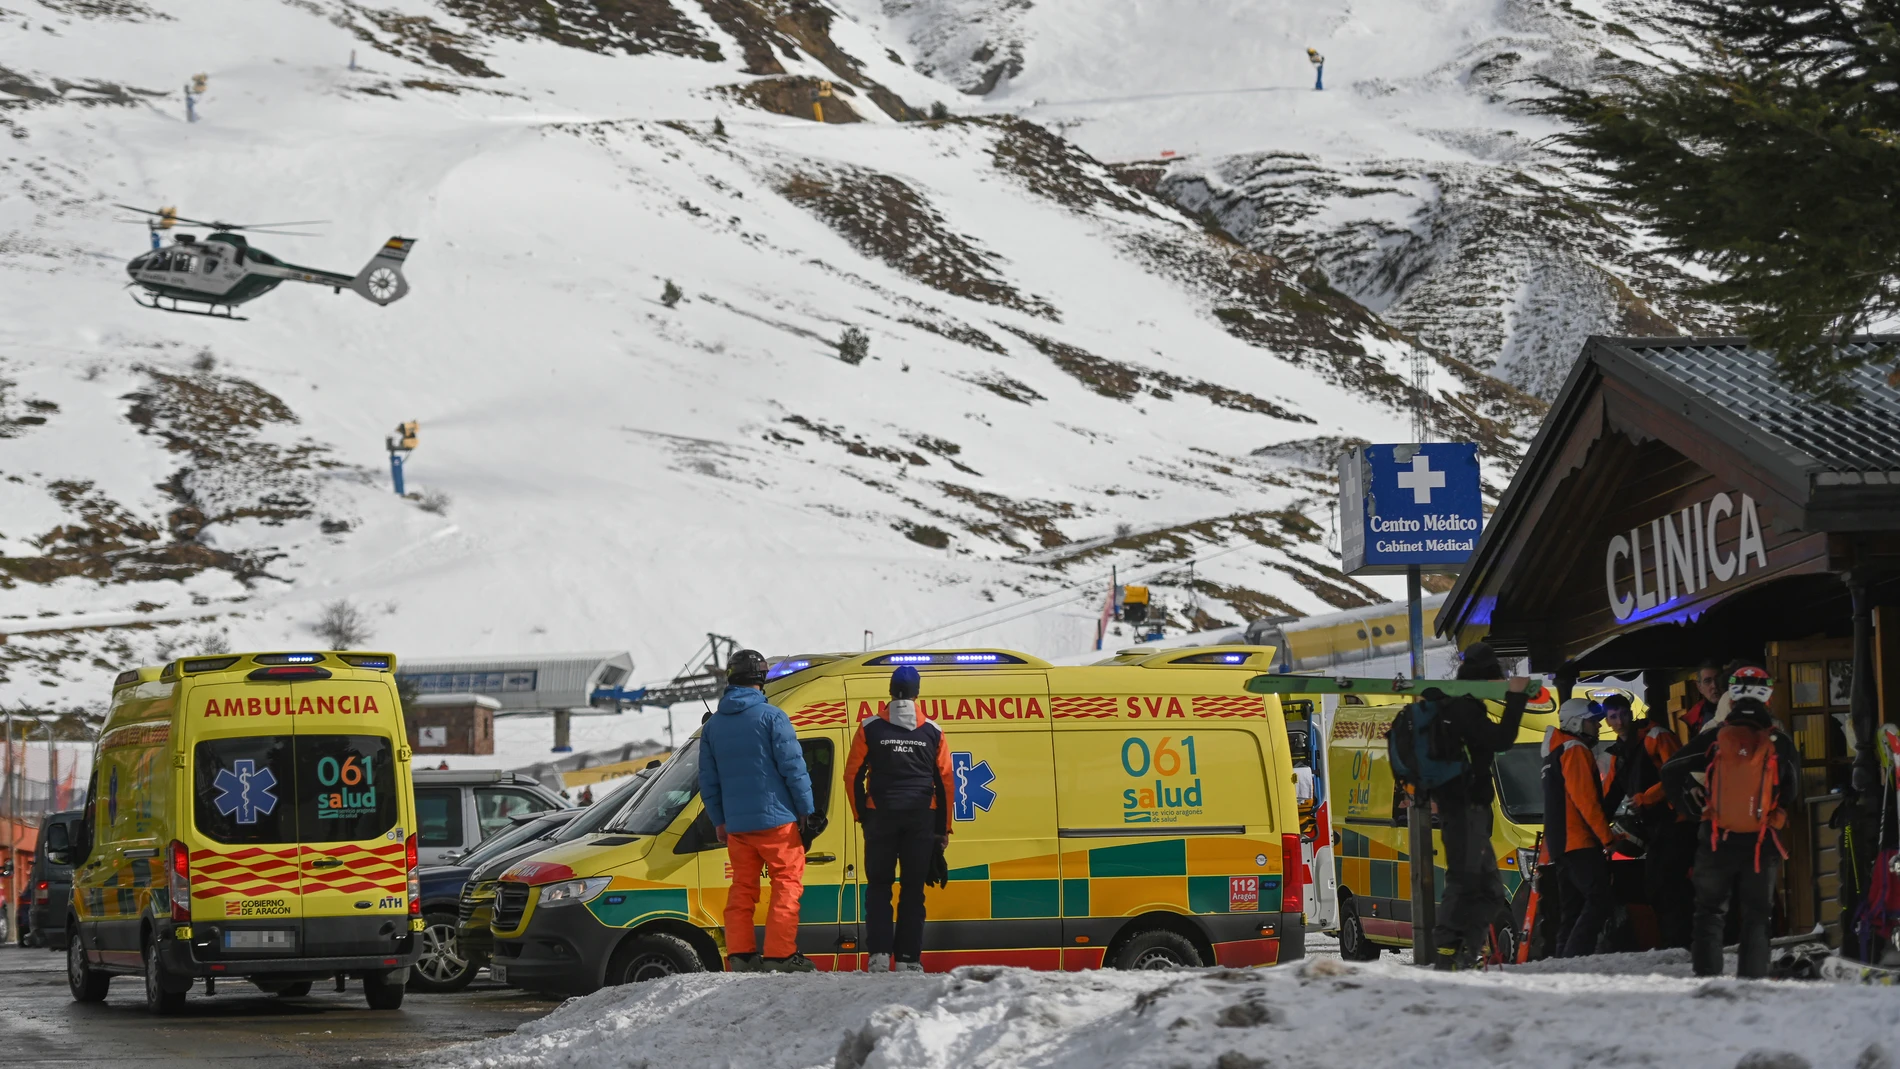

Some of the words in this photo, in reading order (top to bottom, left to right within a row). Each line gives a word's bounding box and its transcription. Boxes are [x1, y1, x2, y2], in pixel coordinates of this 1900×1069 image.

[1370, 515, 1420, 532] Centro
[1423, 513, 1477, 531] Médico
[1376, 540, 1423, 552] Cabinet
[1425, 538, 1473, 551] Médical
[1606, 492, 1767, 620] CLINICA
[204, 695, 379, 717] AMBULANCIA
[855, 697, 1045, 723] AULANCIA
[1126, 696, 1186, 719] SVA
[1359, 722, 1376, 739] SVB
[1121, 735, 1197, 778] 061
[1352, 750, 1374, 781] 061
[317, 755, 373, 787] 061
[317, 786, 376, 809] salud
[1122, 778, 1203, 810] salud
[1349, 783, 1370, 804] salud
[1231, 879, 1257, 892] 112
[241, 899, 285, 908] GOBIERNO
[378, 898, 403, 909] ATH
[1232, 892, 1257, 902] Aragón
[241, 907, 253, 916] DE
